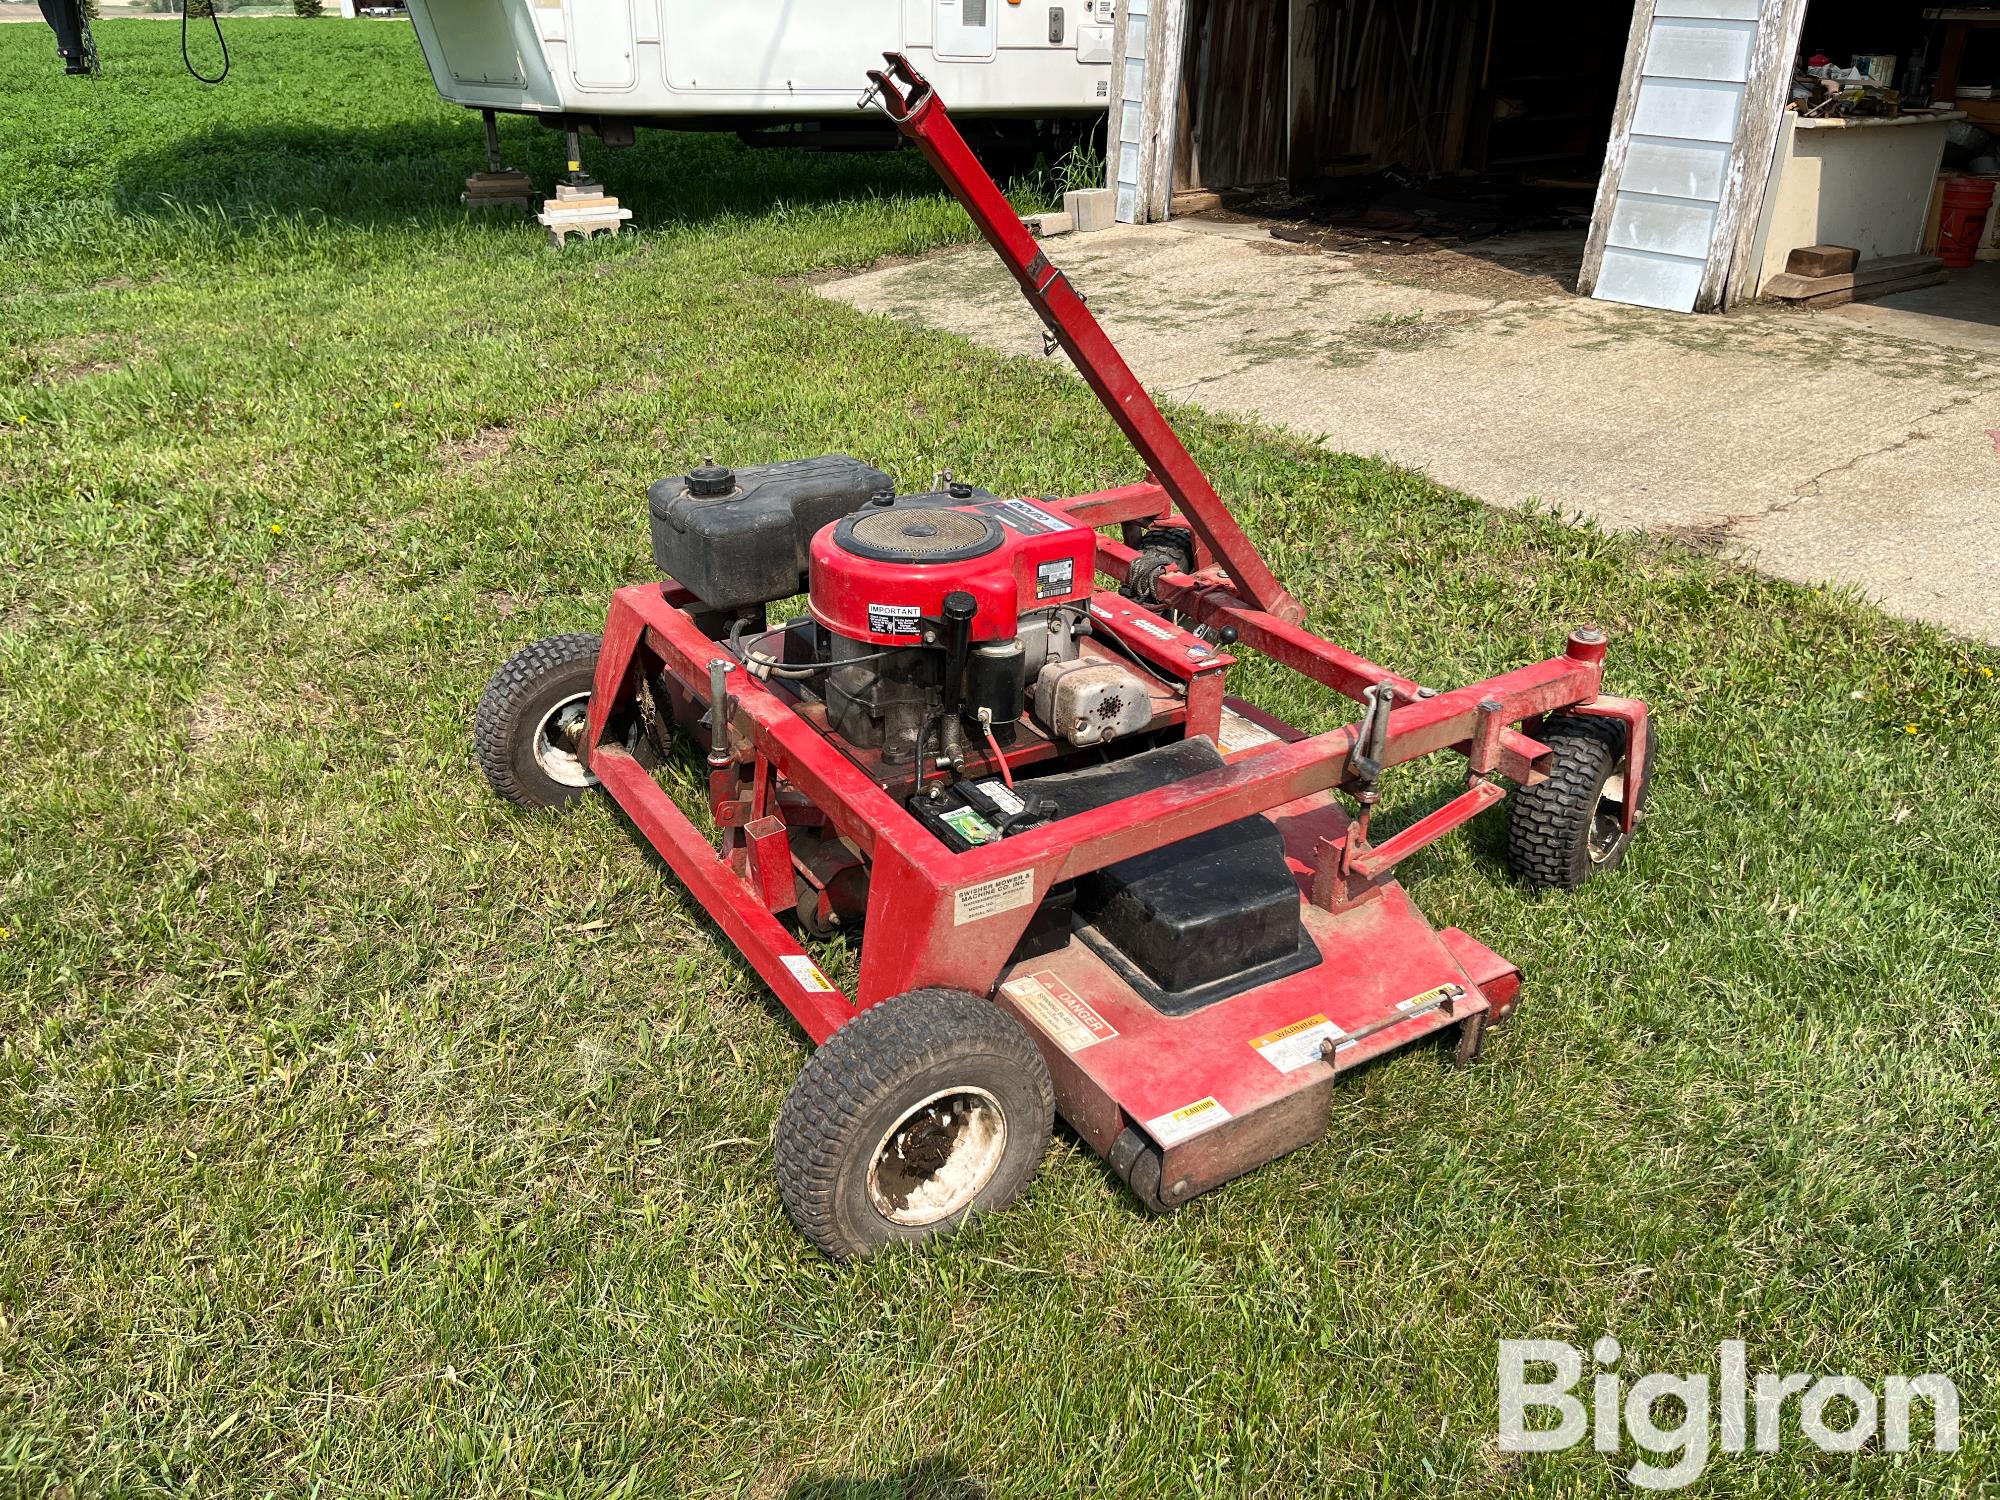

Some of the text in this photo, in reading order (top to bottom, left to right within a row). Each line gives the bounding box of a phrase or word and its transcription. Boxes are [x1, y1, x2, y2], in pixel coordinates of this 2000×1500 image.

[870, 605, 918, 615] IMPORTANT
[959, 884, 993, 898] SWISHER
[995, 873, 1023, 888] MOWER
[961, 890, 996, 903] MACHINE
[1012, 879, 1027, 888] INC.
[1058, 992, 1105, 1031] DANGER
[1275, 1018, 1319, 1038] WARNING
[1184, 1100, 1215, 1116] CAUTION
